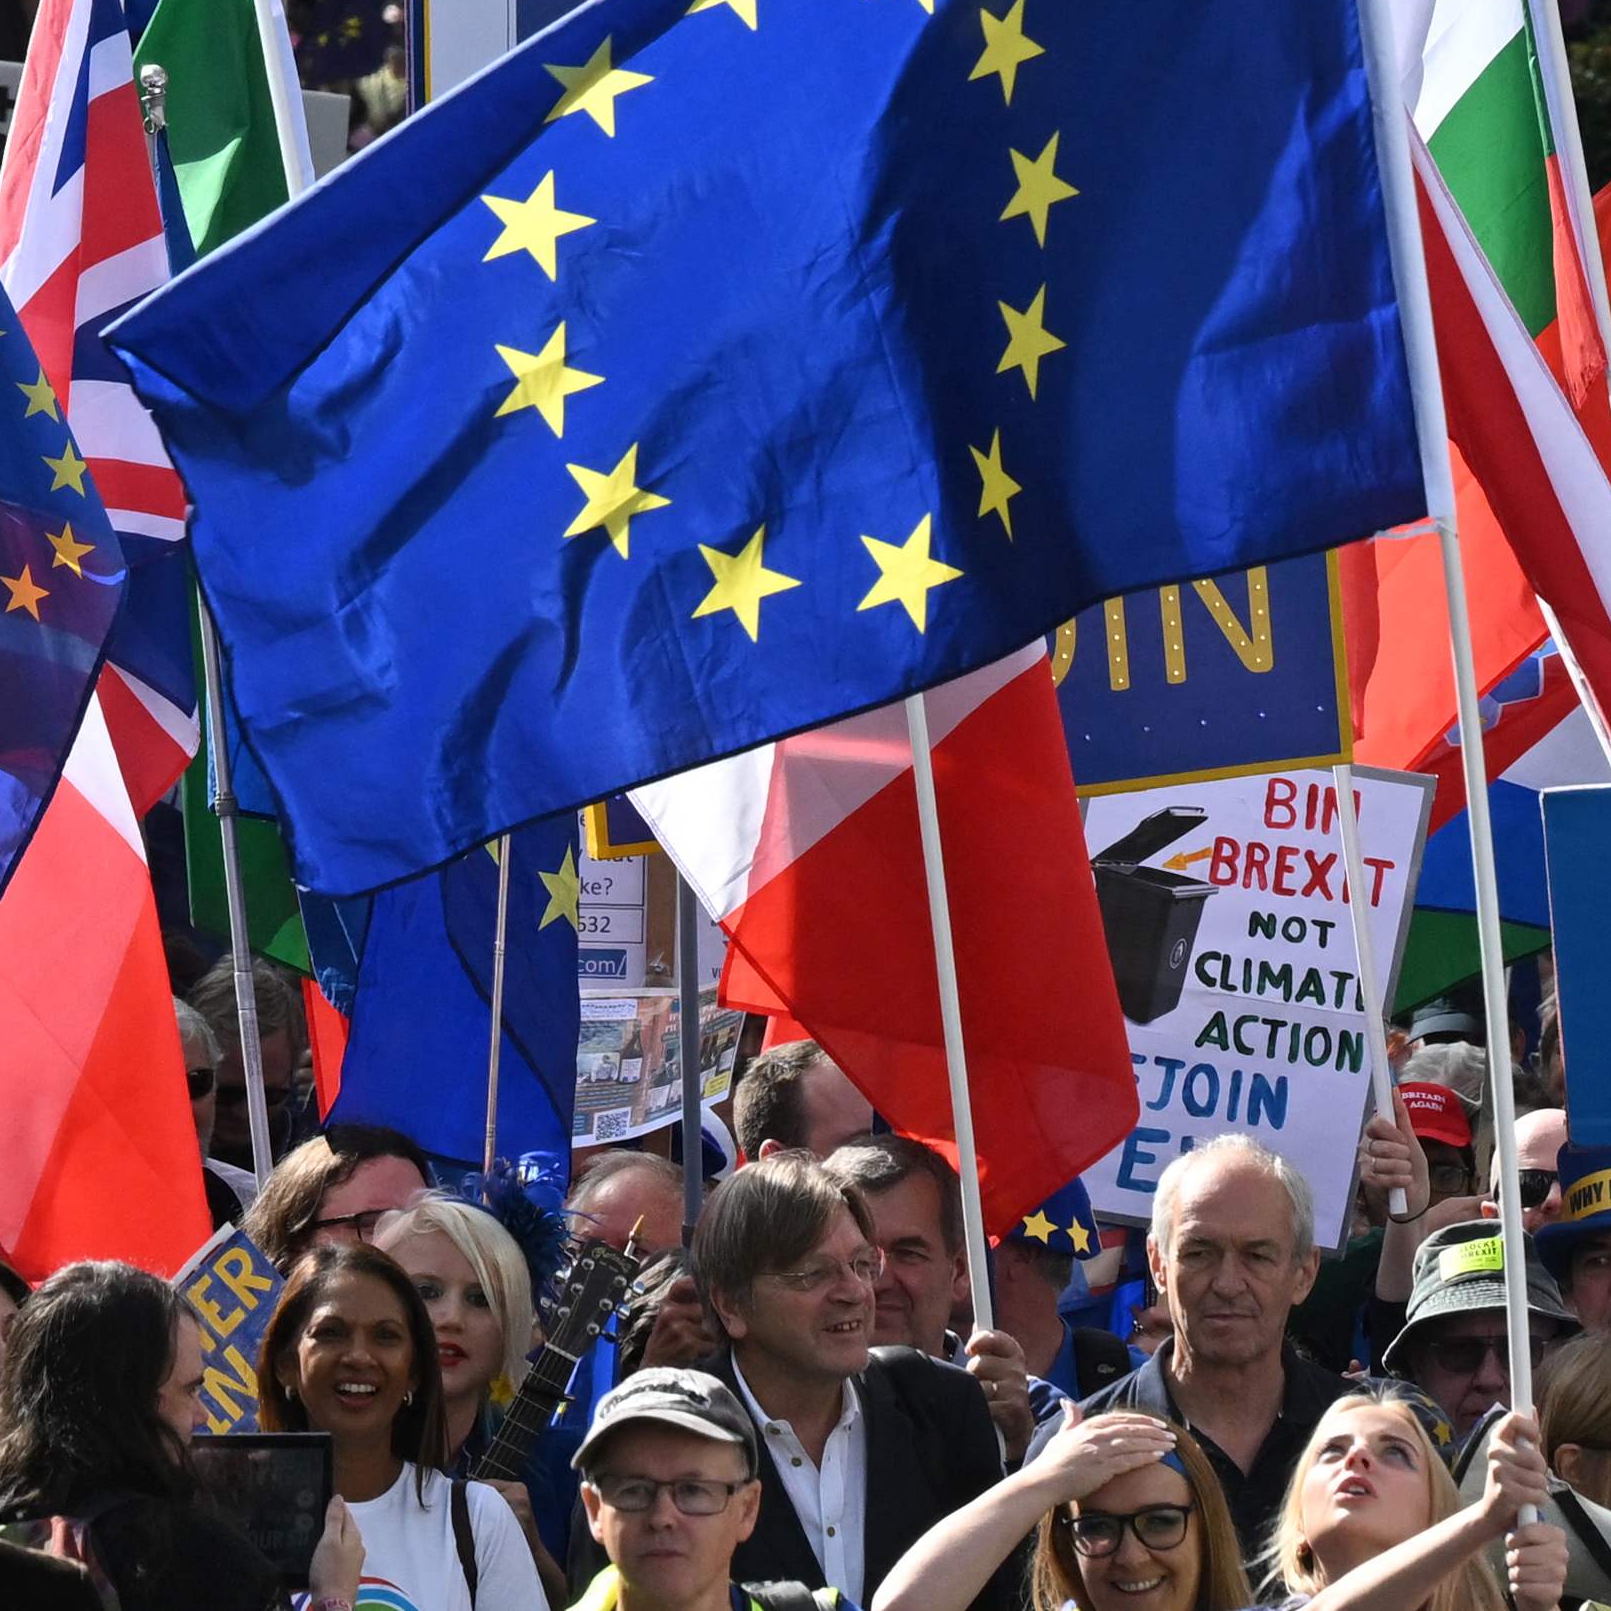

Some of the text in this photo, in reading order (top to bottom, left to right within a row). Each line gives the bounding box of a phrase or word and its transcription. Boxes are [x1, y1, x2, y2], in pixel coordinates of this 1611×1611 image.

[1264, 777, 1362, 836] BIN
[1248, 910, 1336, 949] NOT
[1195, 1010, 1365, 1075] ACTION
[1129, 1053, 1289, 1131] JOIN
[1401, 1090, 1446, 1104] BRITAIN
[1410, 1101, 1443, 1113] AGAIN
[1569, 1178, 1604, 1214] WHY
